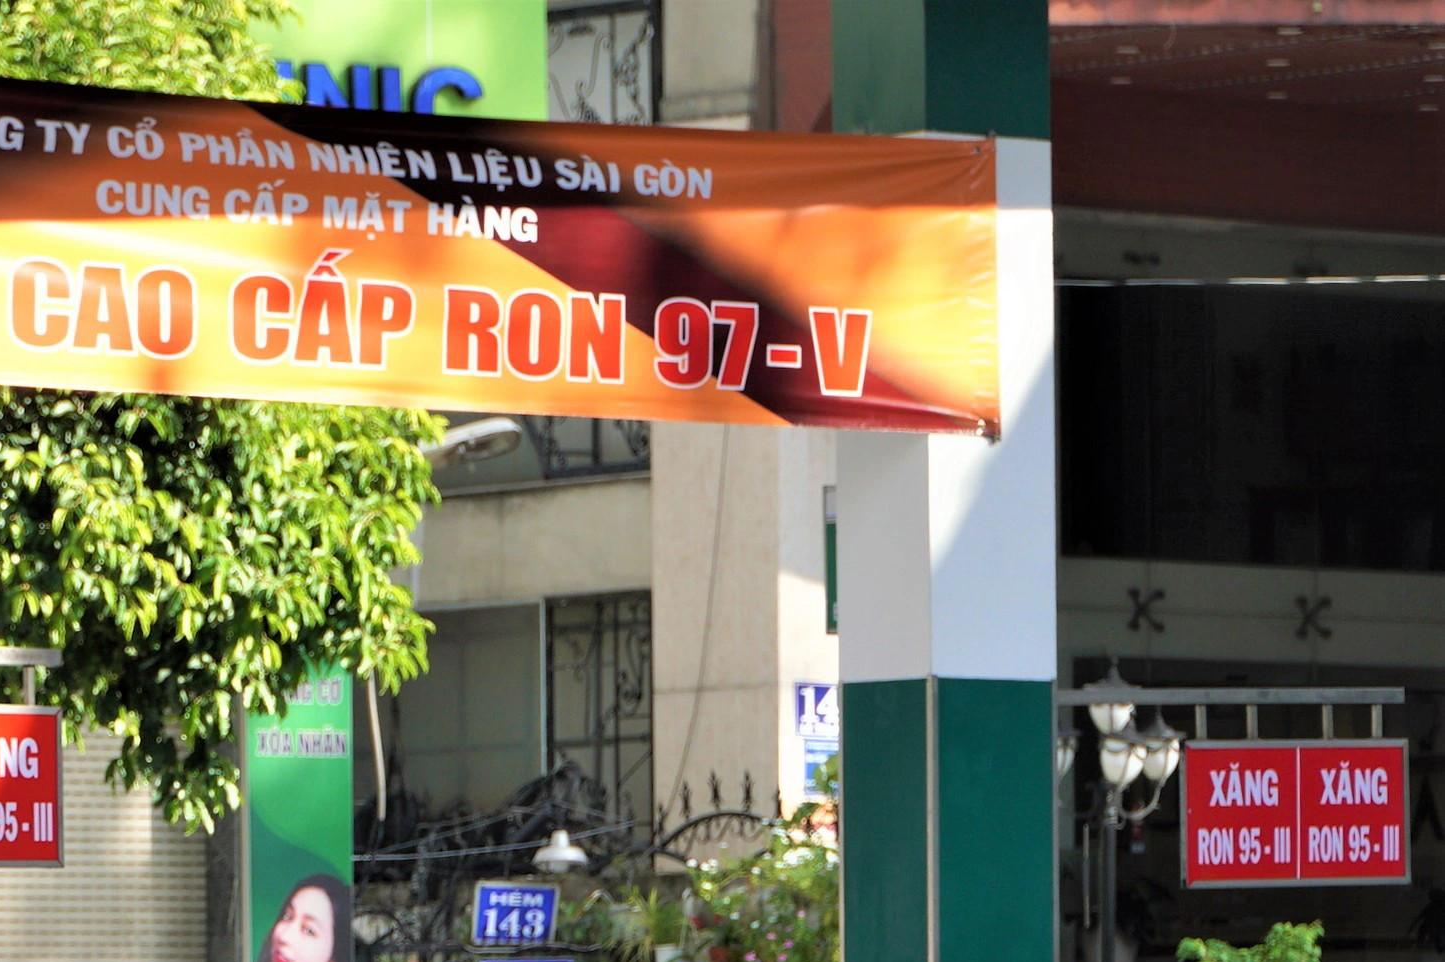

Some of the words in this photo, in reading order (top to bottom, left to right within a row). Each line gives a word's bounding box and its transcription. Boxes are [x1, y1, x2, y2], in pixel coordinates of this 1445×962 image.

[35, 119, 92, 156] TY
[106, 117, 165, 161] CỔ
[178, 127, 296, 170] PHẦN
[306, 141, 437, 181] NHIÊN
[448, 148, 543, 192] LIỆU
[554, 153, 621, 193] SÀI
[633, 157, 713, 199] GÒN
[95, 180, 211, 222] CUNG
[223, 178, 309, 228] CẤP
[323, 193, 412, 240] MẶT
[428, 195, 539, 244] HÀNG
[9, 256, 198, 361] CAO
[229, 248, 416, 371] CẤP
[443, 285, 626, 386] RON
[654, 297, 873, 398] 97-V
[256, 725, 294, 757] XÓA
[1209, 761, 1278, 807] XĂNG
[1320, 760, 1388, 805] XĂNG
[1197, 827, 1234, 865] RON
[1308, 825, 1343, 863] RON
[483, 908, 546, 938] 143
